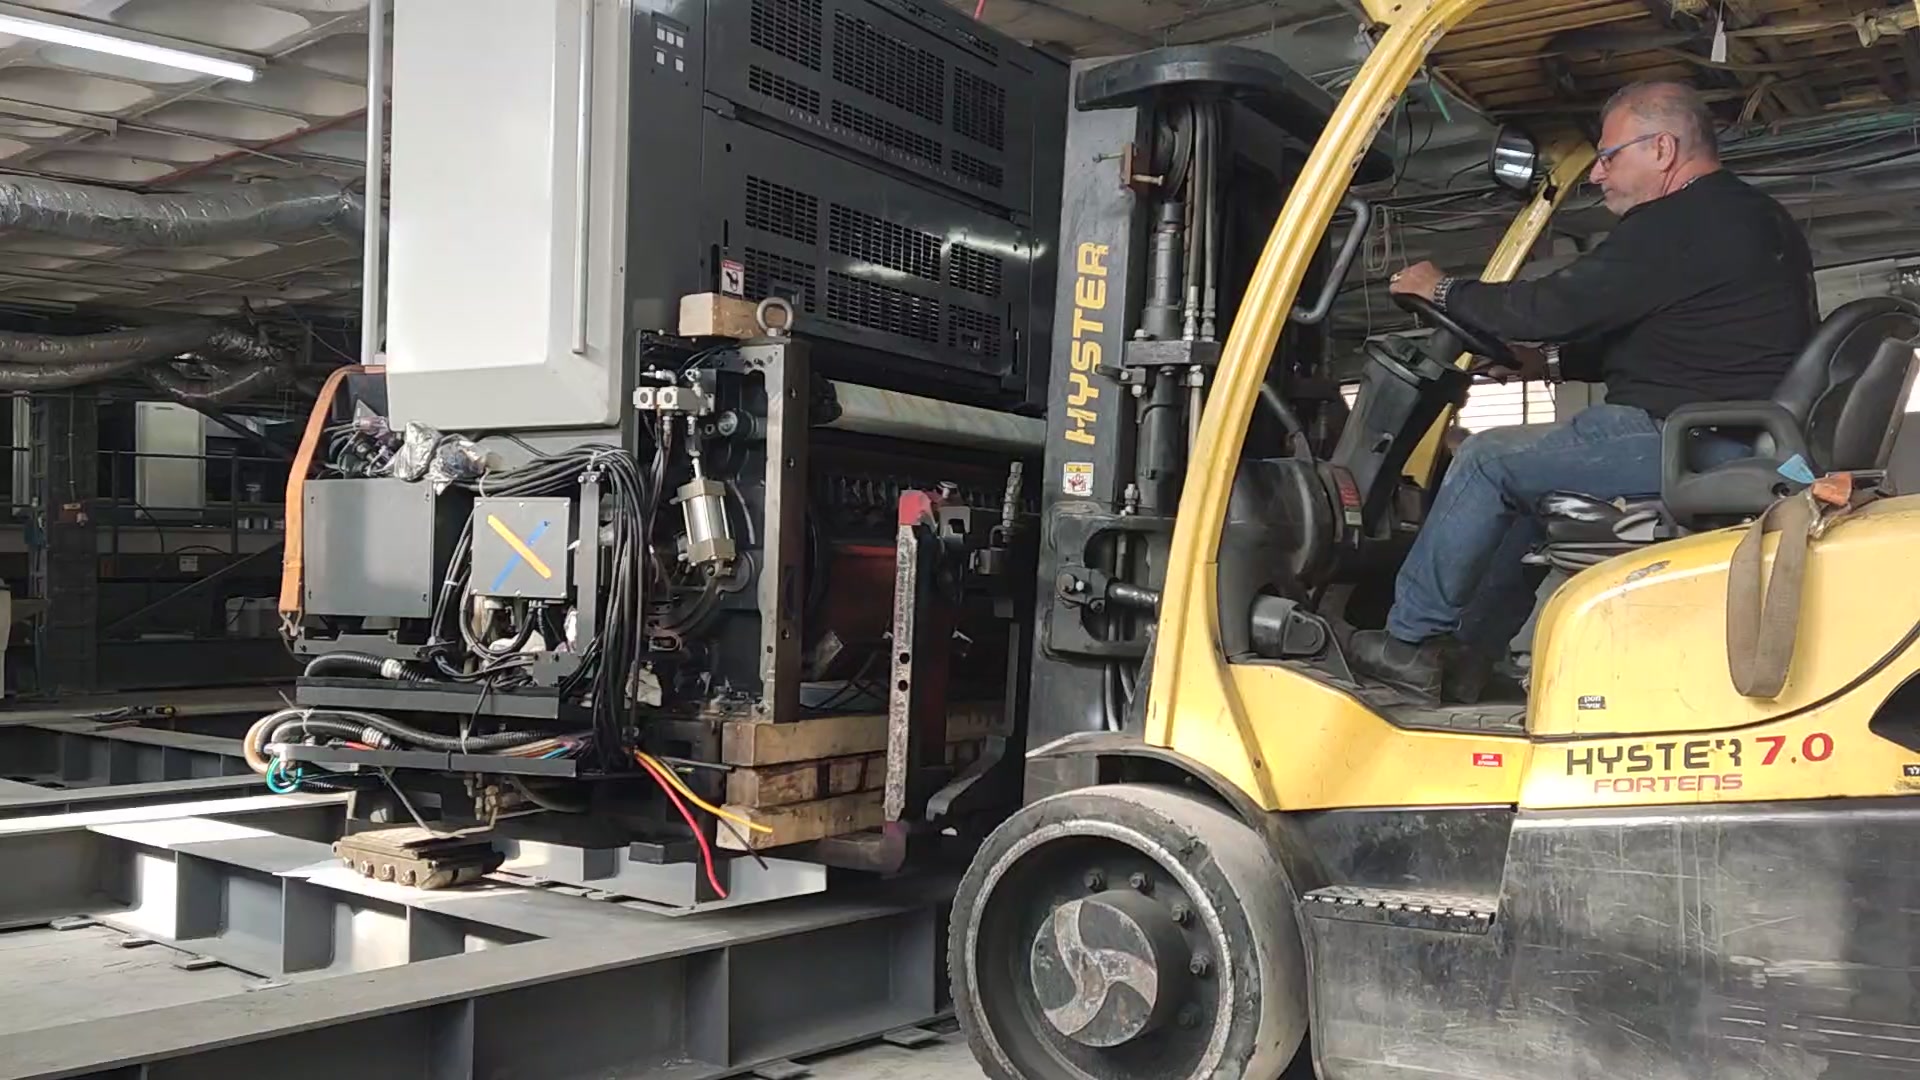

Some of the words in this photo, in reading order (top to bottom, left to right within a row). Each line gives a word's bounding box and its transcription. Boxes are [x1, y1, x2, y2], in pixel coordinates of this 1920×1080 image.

[1065, 242, 1109, 446] HYSTER
[1755, 732, 1834, 766] 7.0
[1594, 774, 1743, 793] FORTENS
